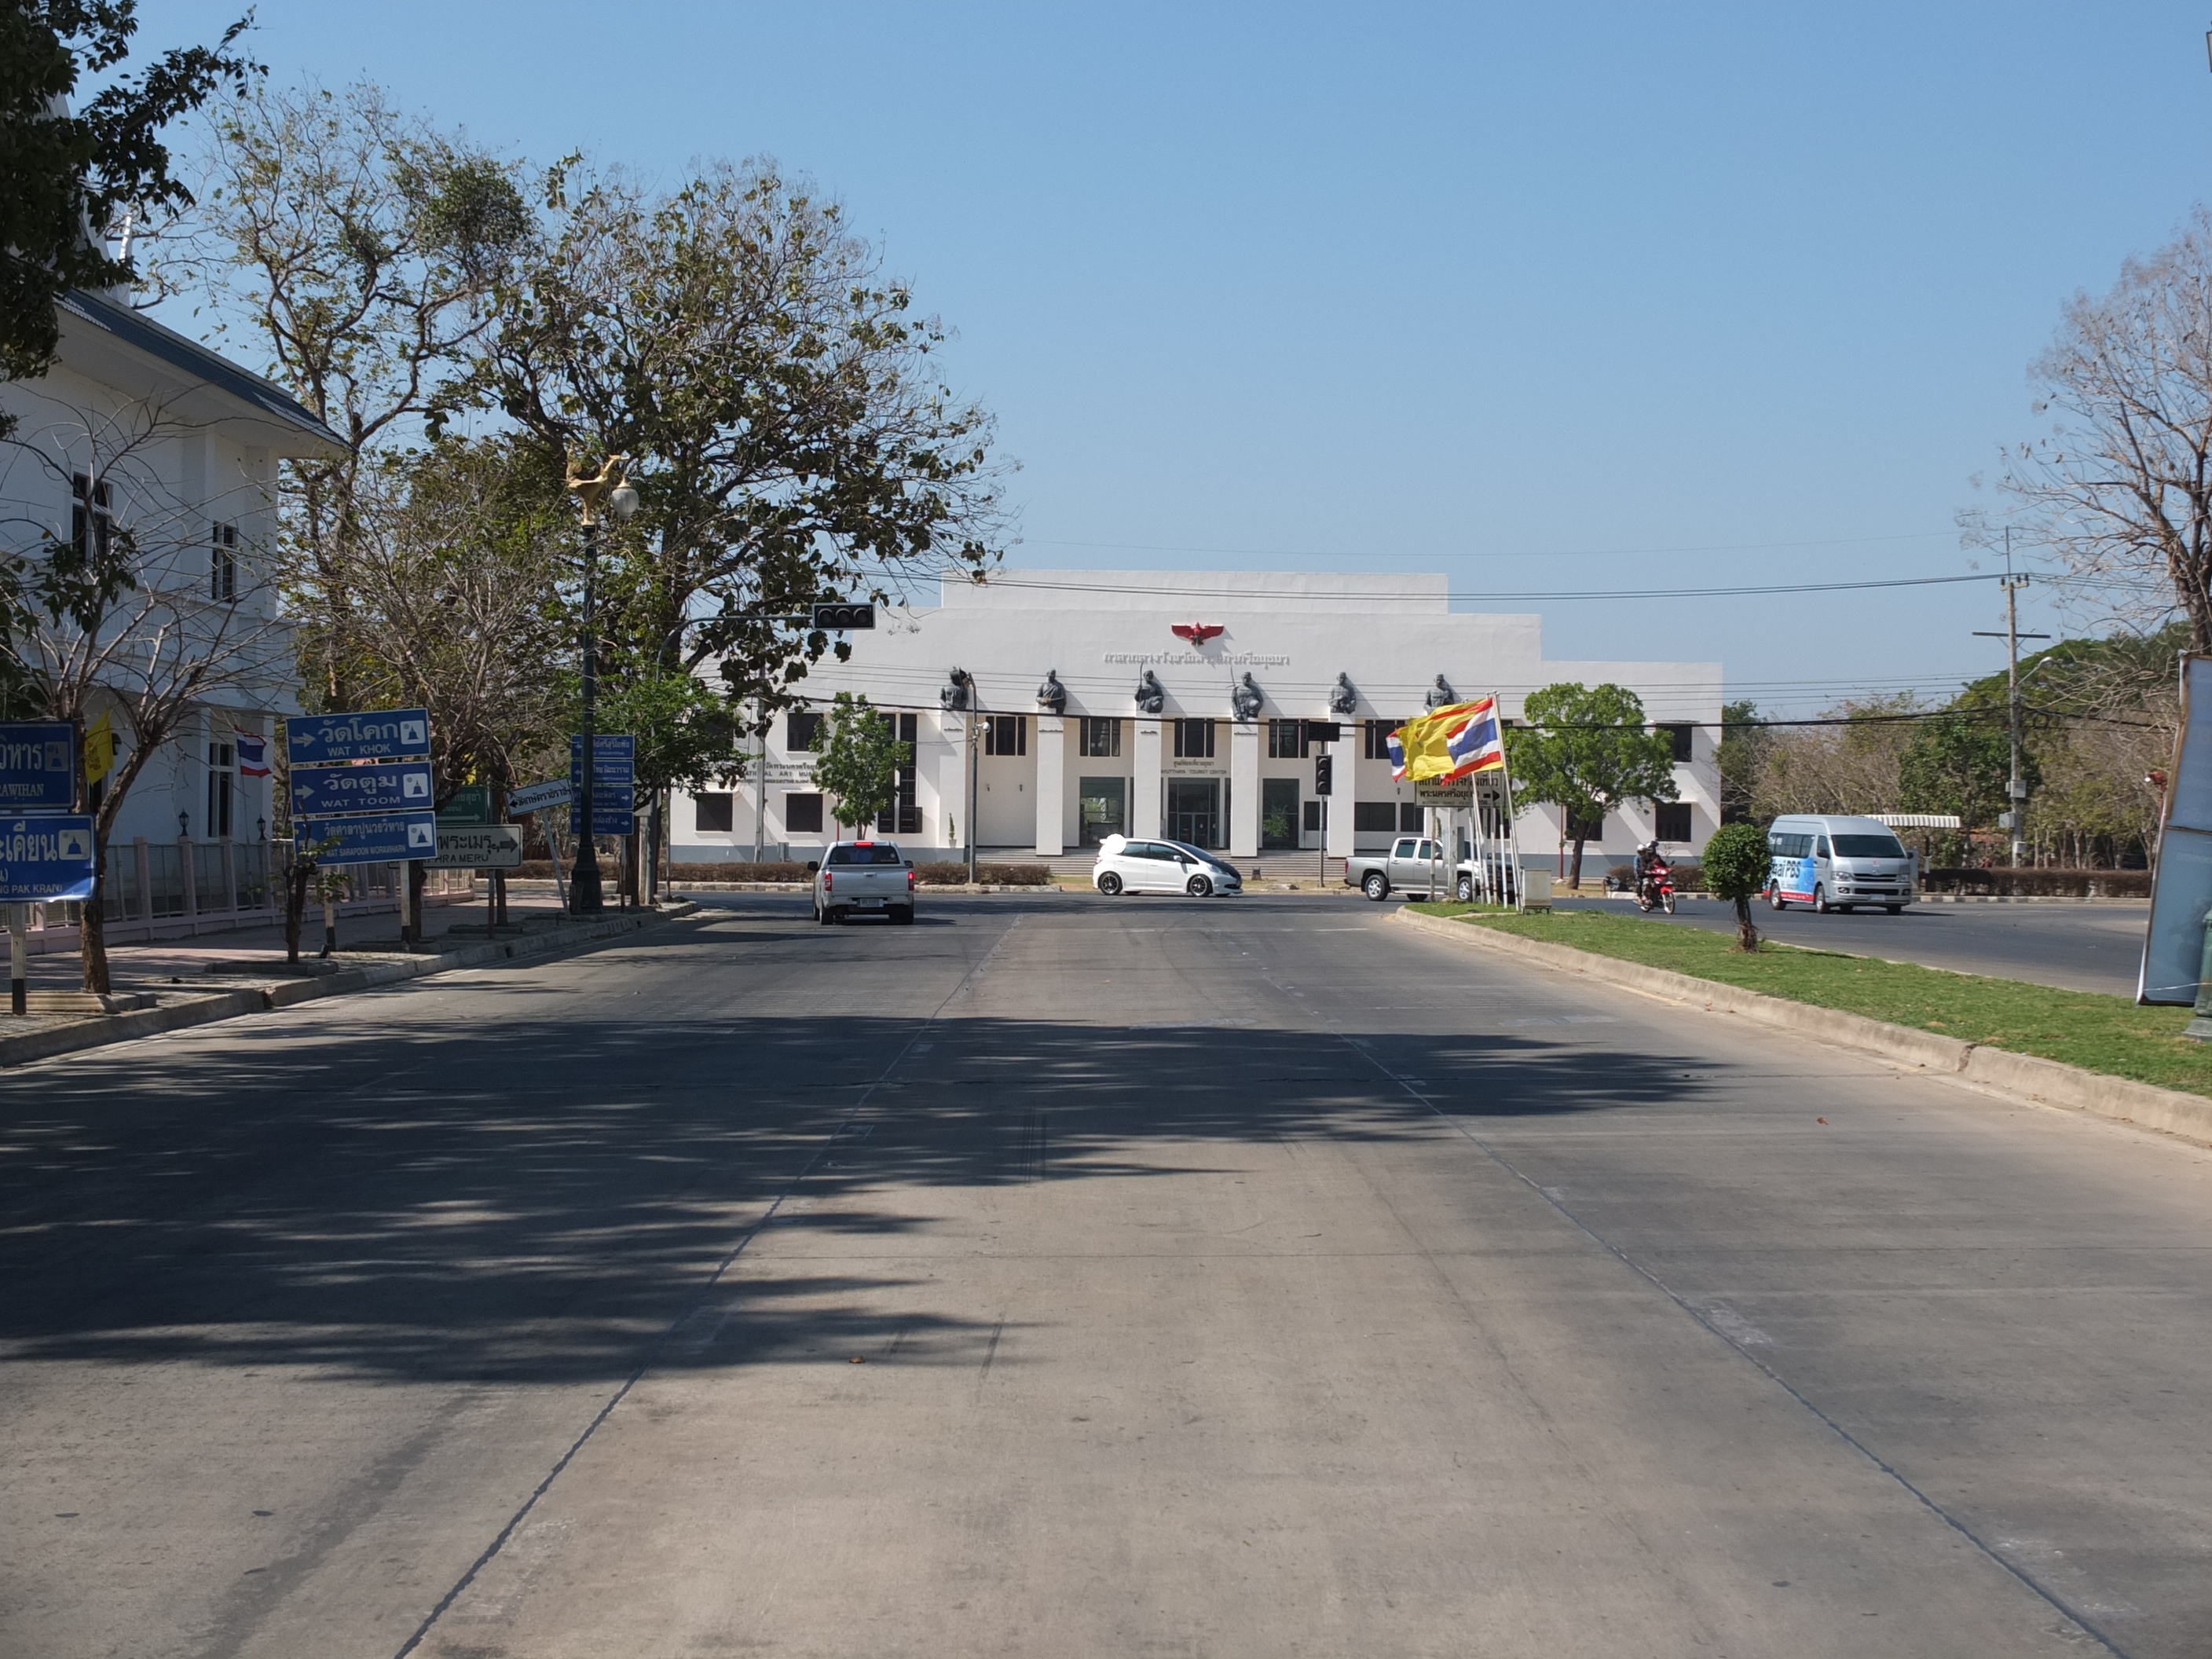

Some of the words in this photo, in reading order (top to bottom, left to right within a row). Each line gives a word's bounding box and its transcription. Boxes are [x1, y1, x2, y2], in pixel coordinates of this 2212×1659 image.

[317, 717, 399, 743] วัดโคก
[328, 746, 351, 756] WAT
[360, 744, 391, 755] KHOK
[324, 773, 397, 794] วัดตูม
[321, 799, 350, 808] WAT
[358, 797, 401, 806] TOOM
[326, 849, 338, 858] WAT
[460, 853, 489, 862] MERU
[1786, 860, 1801, 879] PBS
[12, 884, 30, 894] PAK
